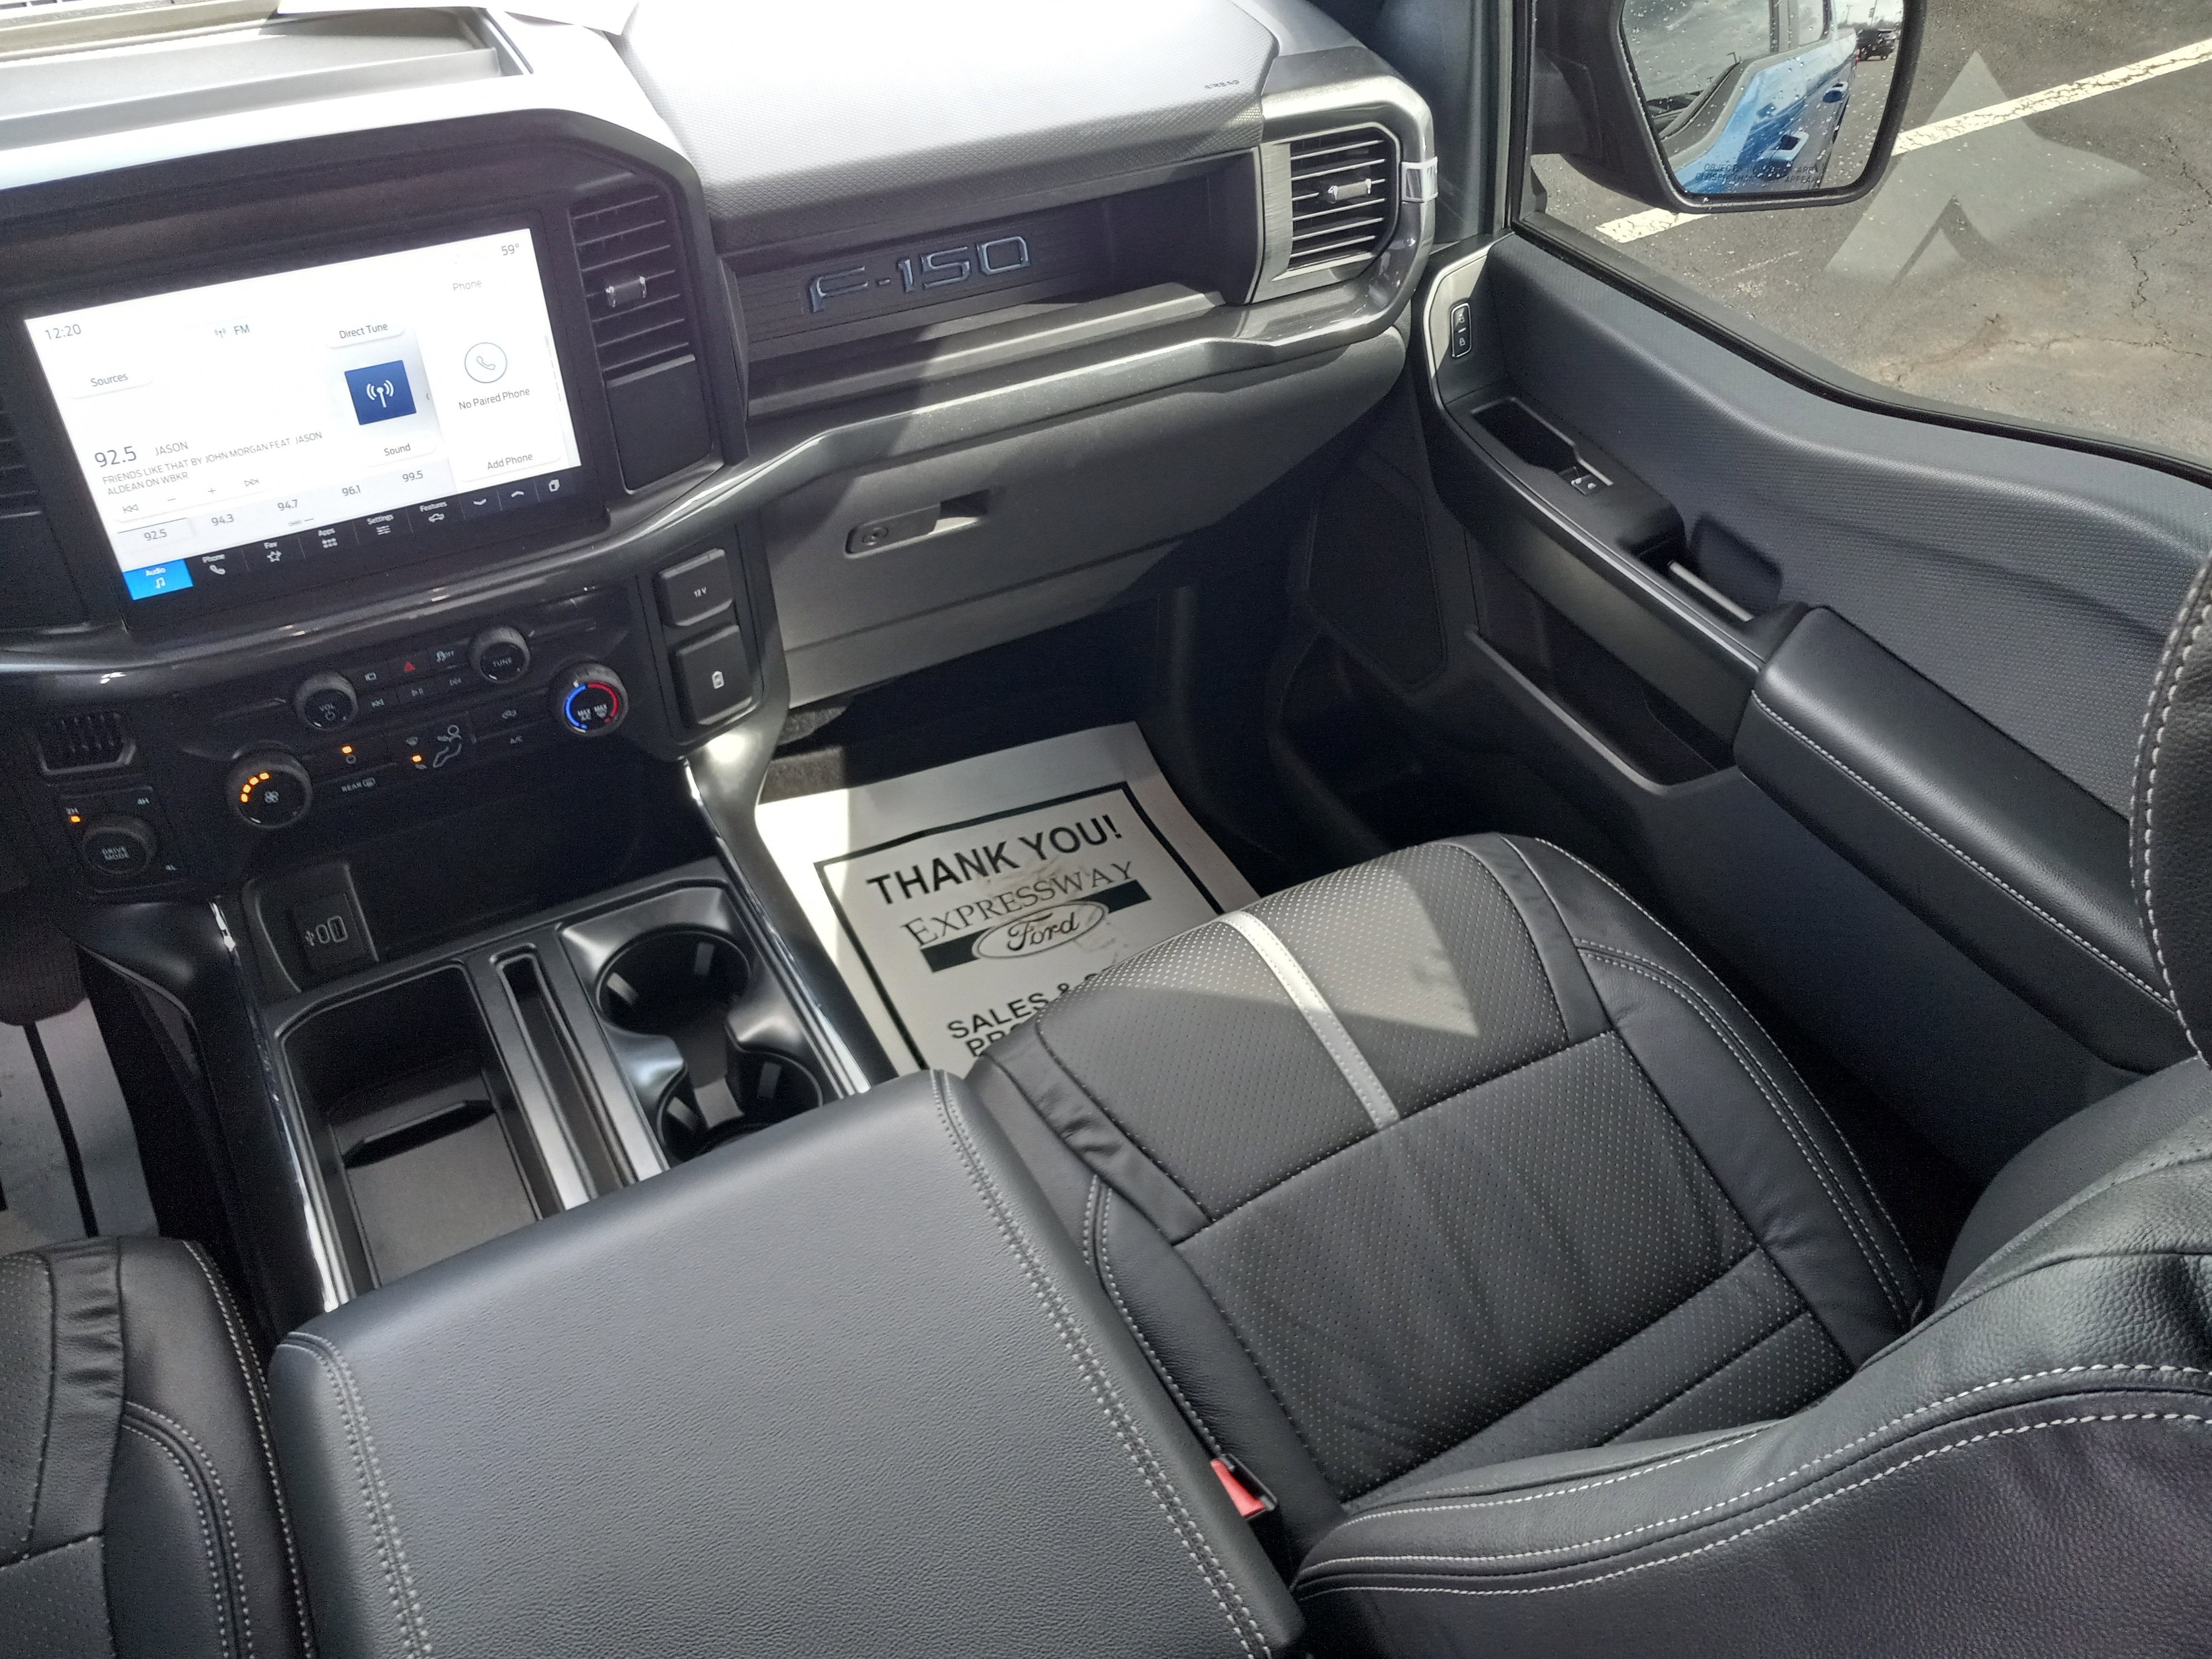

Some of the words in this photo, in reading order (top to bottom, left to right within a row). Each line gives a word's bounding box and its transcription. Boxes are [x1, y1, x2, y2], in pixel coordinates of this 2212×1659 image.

[501, 243, 519, 256] 59°
[807, 236, 1031, 313] F-150
[452, 279, 481, 291] Phone
[45, 324, 81, 340] 12:20
[234, 325, 250, 335] FM
[339, 327, 364, 339] Direct
[365, 323, 388, 335] Tune
[90, 373, 129, 387] Sources
[458, 400, 472, 410] No
[473, 394, 501, 407] Paired
[503, 388, 530, 401] Phone
[155, 441, 188, 456] JASON
[384, 443, 411, 456] Sound
[95, 446, 137, 468] 92.5
[102, 469, 142, 484] FRIENDS
[143, 465, 164, 476] LIKE
[165, 459, 188, 471] THAT
[191, 457, 202, 466] BY
[206, 452, 228, 463] JOHN
[229, 444, 269, 457] MORGAN
[270, 438, 290, 449] FEAT
[296, 432, 322, 445] JASON
[487, 460, 504, 470] Add
[505, 453, 533, 467] Phone
[402, 470, 423, 482] 99.5
[108, 481, 144, 495] ALDEAN
[145, 478, 159, 487] ON
[161, 472, 189, 484] WBKR
[342, 485, 361, 496] 96.1
[277, 499, 298, 511] 94.7
[420, 501, 447, 512] Features
[211, 514, 234, 526] 94.3
[366, 513, 394, 525] Settings
[144, 528, 168, 541] 92.5
[318, 527, 336, 537] Apps
[202, 553, 226, 564] Phone
[145, 566, 167, 577] Audio
[492, 657, 512, 667] TUNE
[319, 703, 335, 711] VOL
[341, 781, 362, 792] REAR
[866, 841, 1020, 905] THANK
[1018, 814, 1122, 861] YOU!
[901, 861, 1133, 947] EXPRESSWAY
[1007, 911, 1080, 951] Ford
[947, 992, 1049, 1039] SALES
